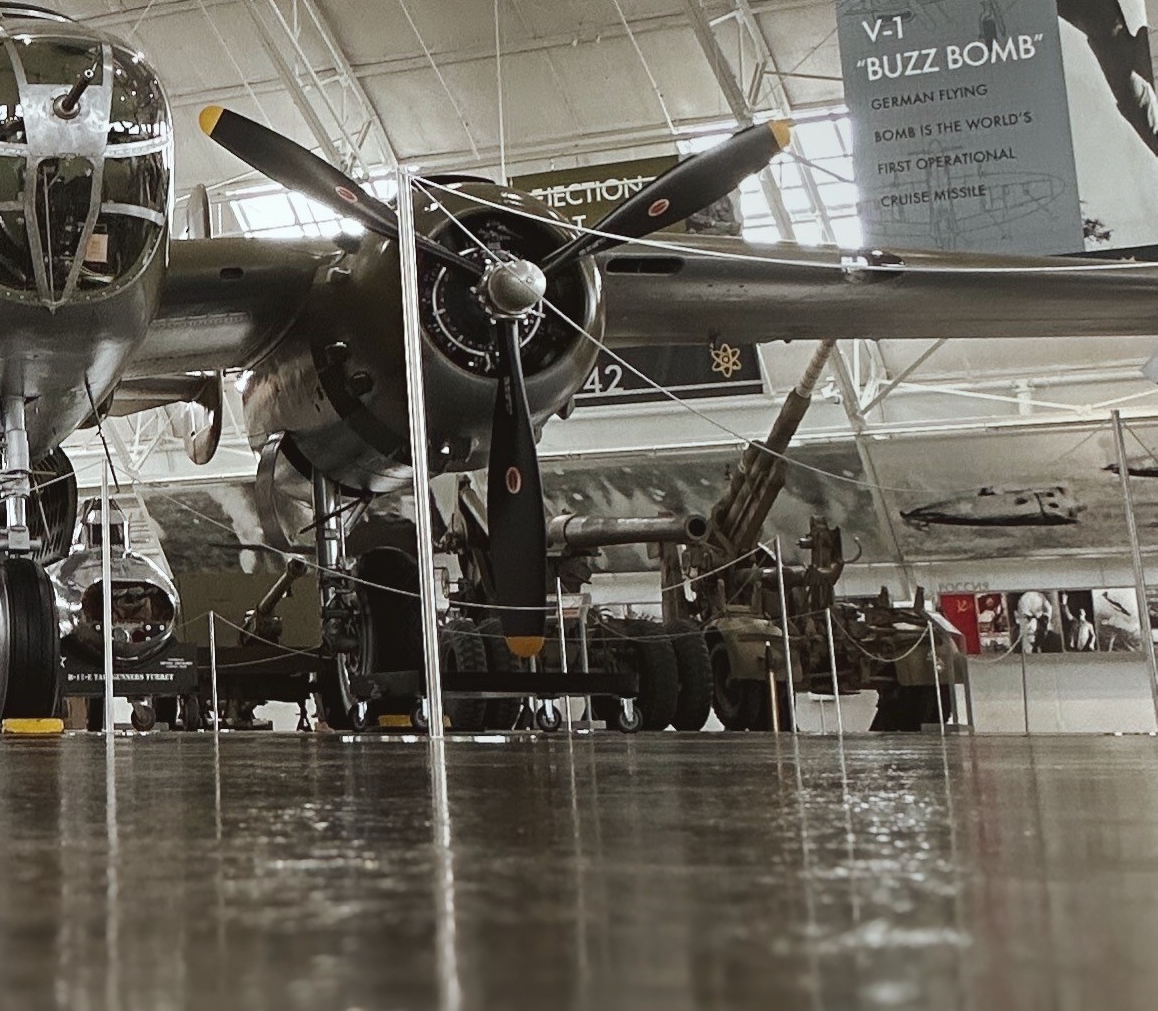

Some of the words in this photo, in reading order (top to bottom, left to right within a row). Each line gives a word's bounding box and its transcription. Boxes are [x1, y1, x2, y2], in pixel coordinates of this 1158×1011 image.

[862, 15, 905, 43] V-1
[856, 46, 940, 82] "BUZZ
[946, 33, 1044, 71] BOMB"
[871, 90, 934, 111] GERMAN
[940, 84, 989, 103] FLYING
[875, 125, 916, 143] BOMB
[919, 122, 933, 137] IS
[937, 120, 963, 135] THE
[965, 111, 1033, 131] WORLD'S
[877, 158, 912, 176] FIRST
[916, 147, 1017, 171] OPERATIONAL
[881, 189, 930, 208] CRUISE
[932, 184, 987, 202] MISSILE
[583, 364, 625, 394] 42
